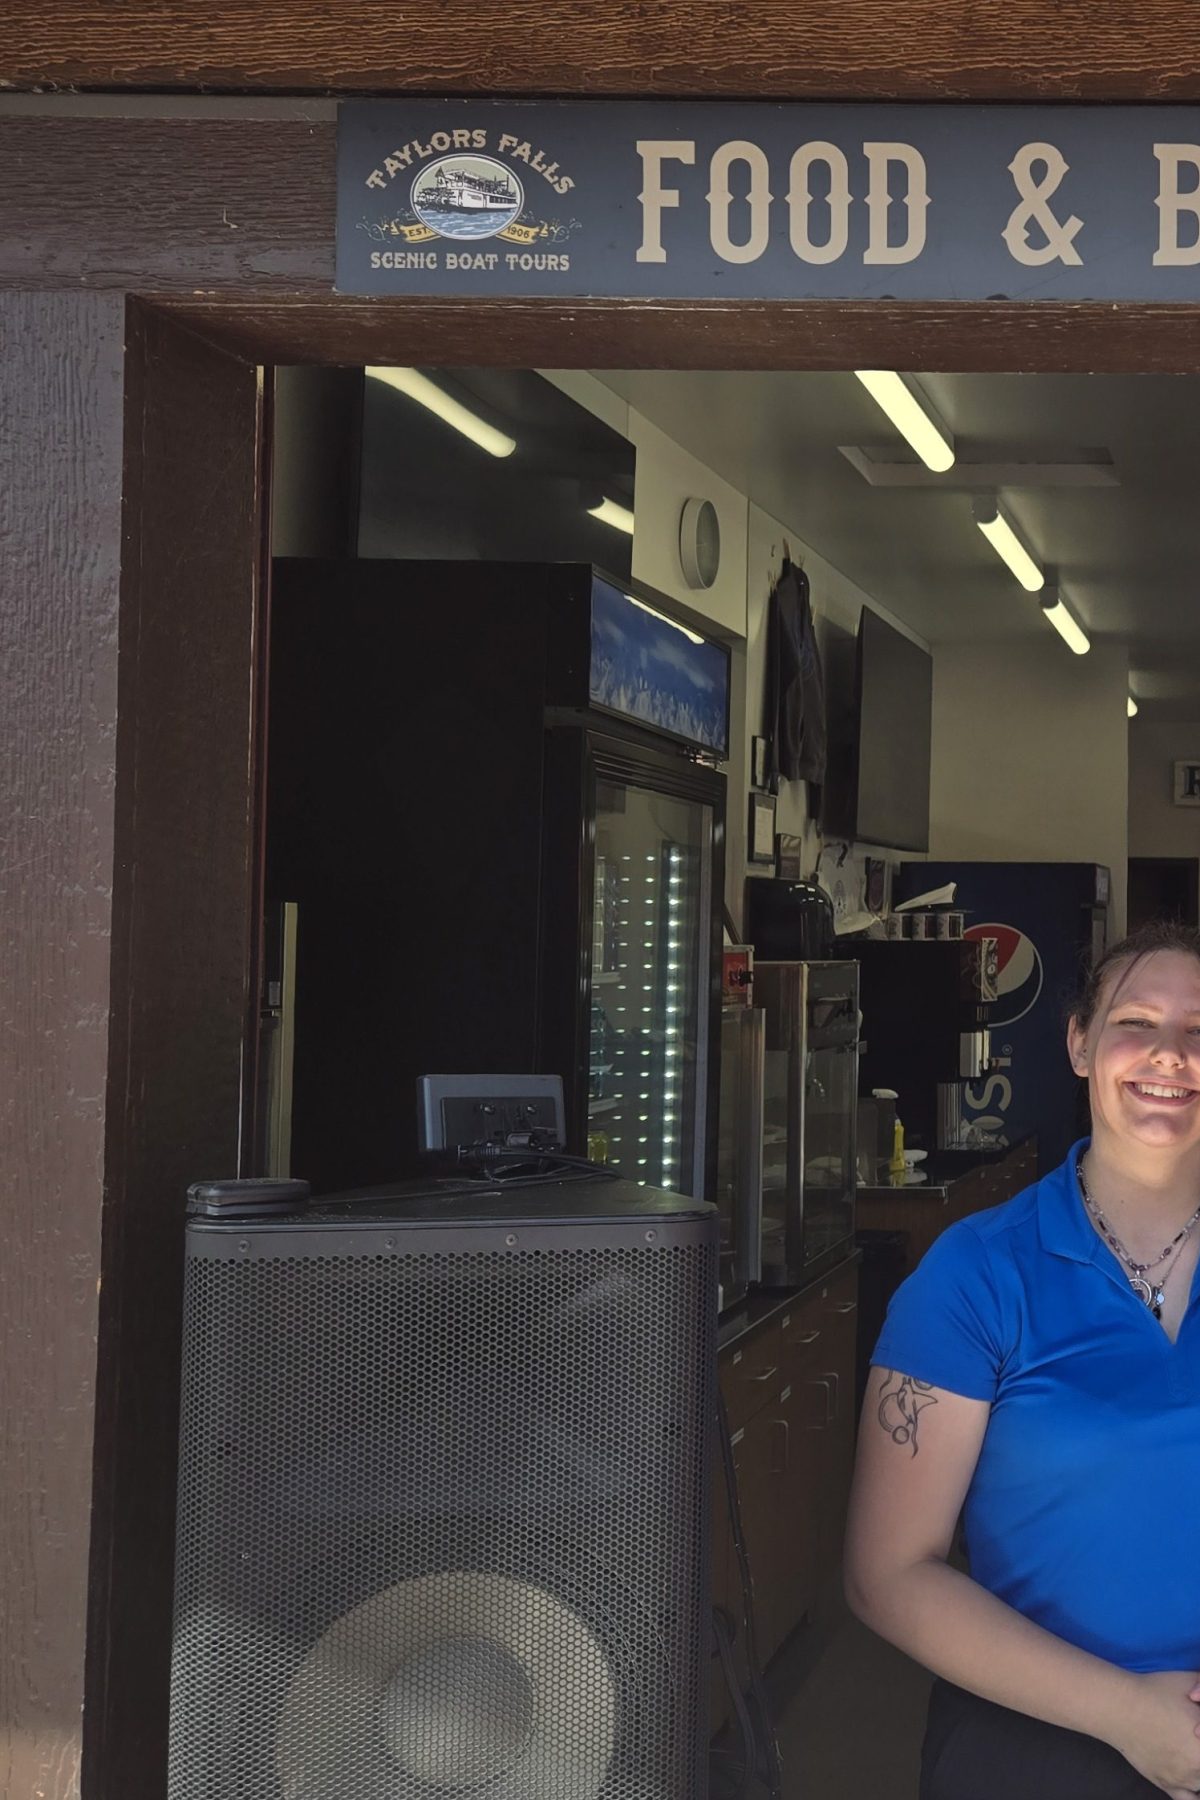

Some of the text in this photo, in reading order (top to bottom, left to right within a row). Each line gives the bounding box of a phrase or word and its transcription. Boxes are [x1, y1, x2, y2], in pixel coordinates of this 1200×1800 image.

[365, 129, 576, 194] TAYLORS FALLS
[635, 139, 933, 266] FOOD
[1001, 141, 1085, 267] &
[408, 226, 431, 237] EST.
[507, 225, 530, 239] 1906
[370, 251, 570, 271] SCENIC BOAT TOURS
